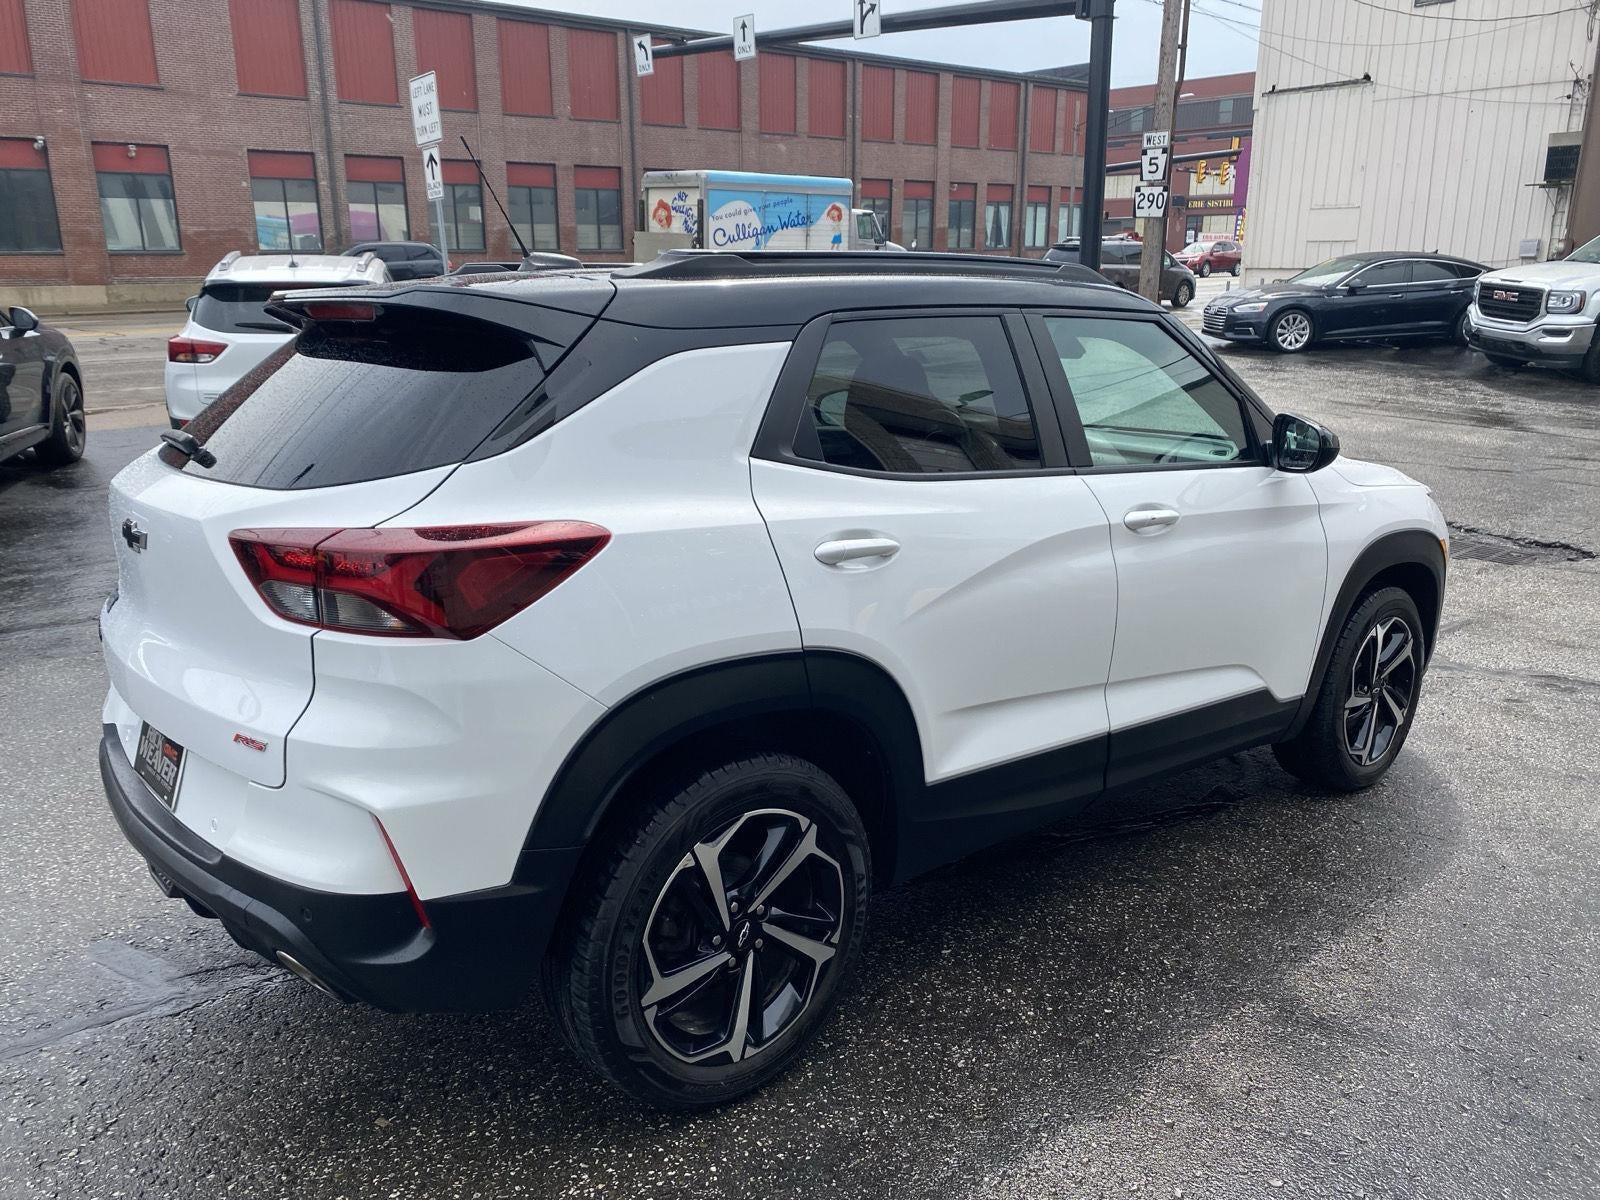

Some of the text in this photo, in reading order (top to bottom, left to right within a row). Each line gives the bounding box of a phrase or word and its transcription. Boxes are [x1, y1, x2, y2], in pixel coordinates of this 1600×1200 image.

[737, 44, 752, 55] ONLY
[638, 63, 651, 73] ONLY
[412, 81, 435, 99] LEFT LANE
[418, 102, 433, 117] MUST
[417, 121, 439, 137] TURN LEFT
[1146, 135, 1167, 146] WEST
[1148, 156, 1159, 174] 5
[677, 190, 689, 203] HEY
[1137, 192, 1165, 210] 290
[1188, 200, 1205, 208] ERIE
[724, 208, 742, 218] could
[743, 206, 757, 217] give
[758, 203, 771, 212] your
[773, 197, 793, 210] people
[713, 210, 813, 247] Culligan Water
[1493, 290, 1520, 302] GMC
[140, 735, 178, 787] WEAVER
